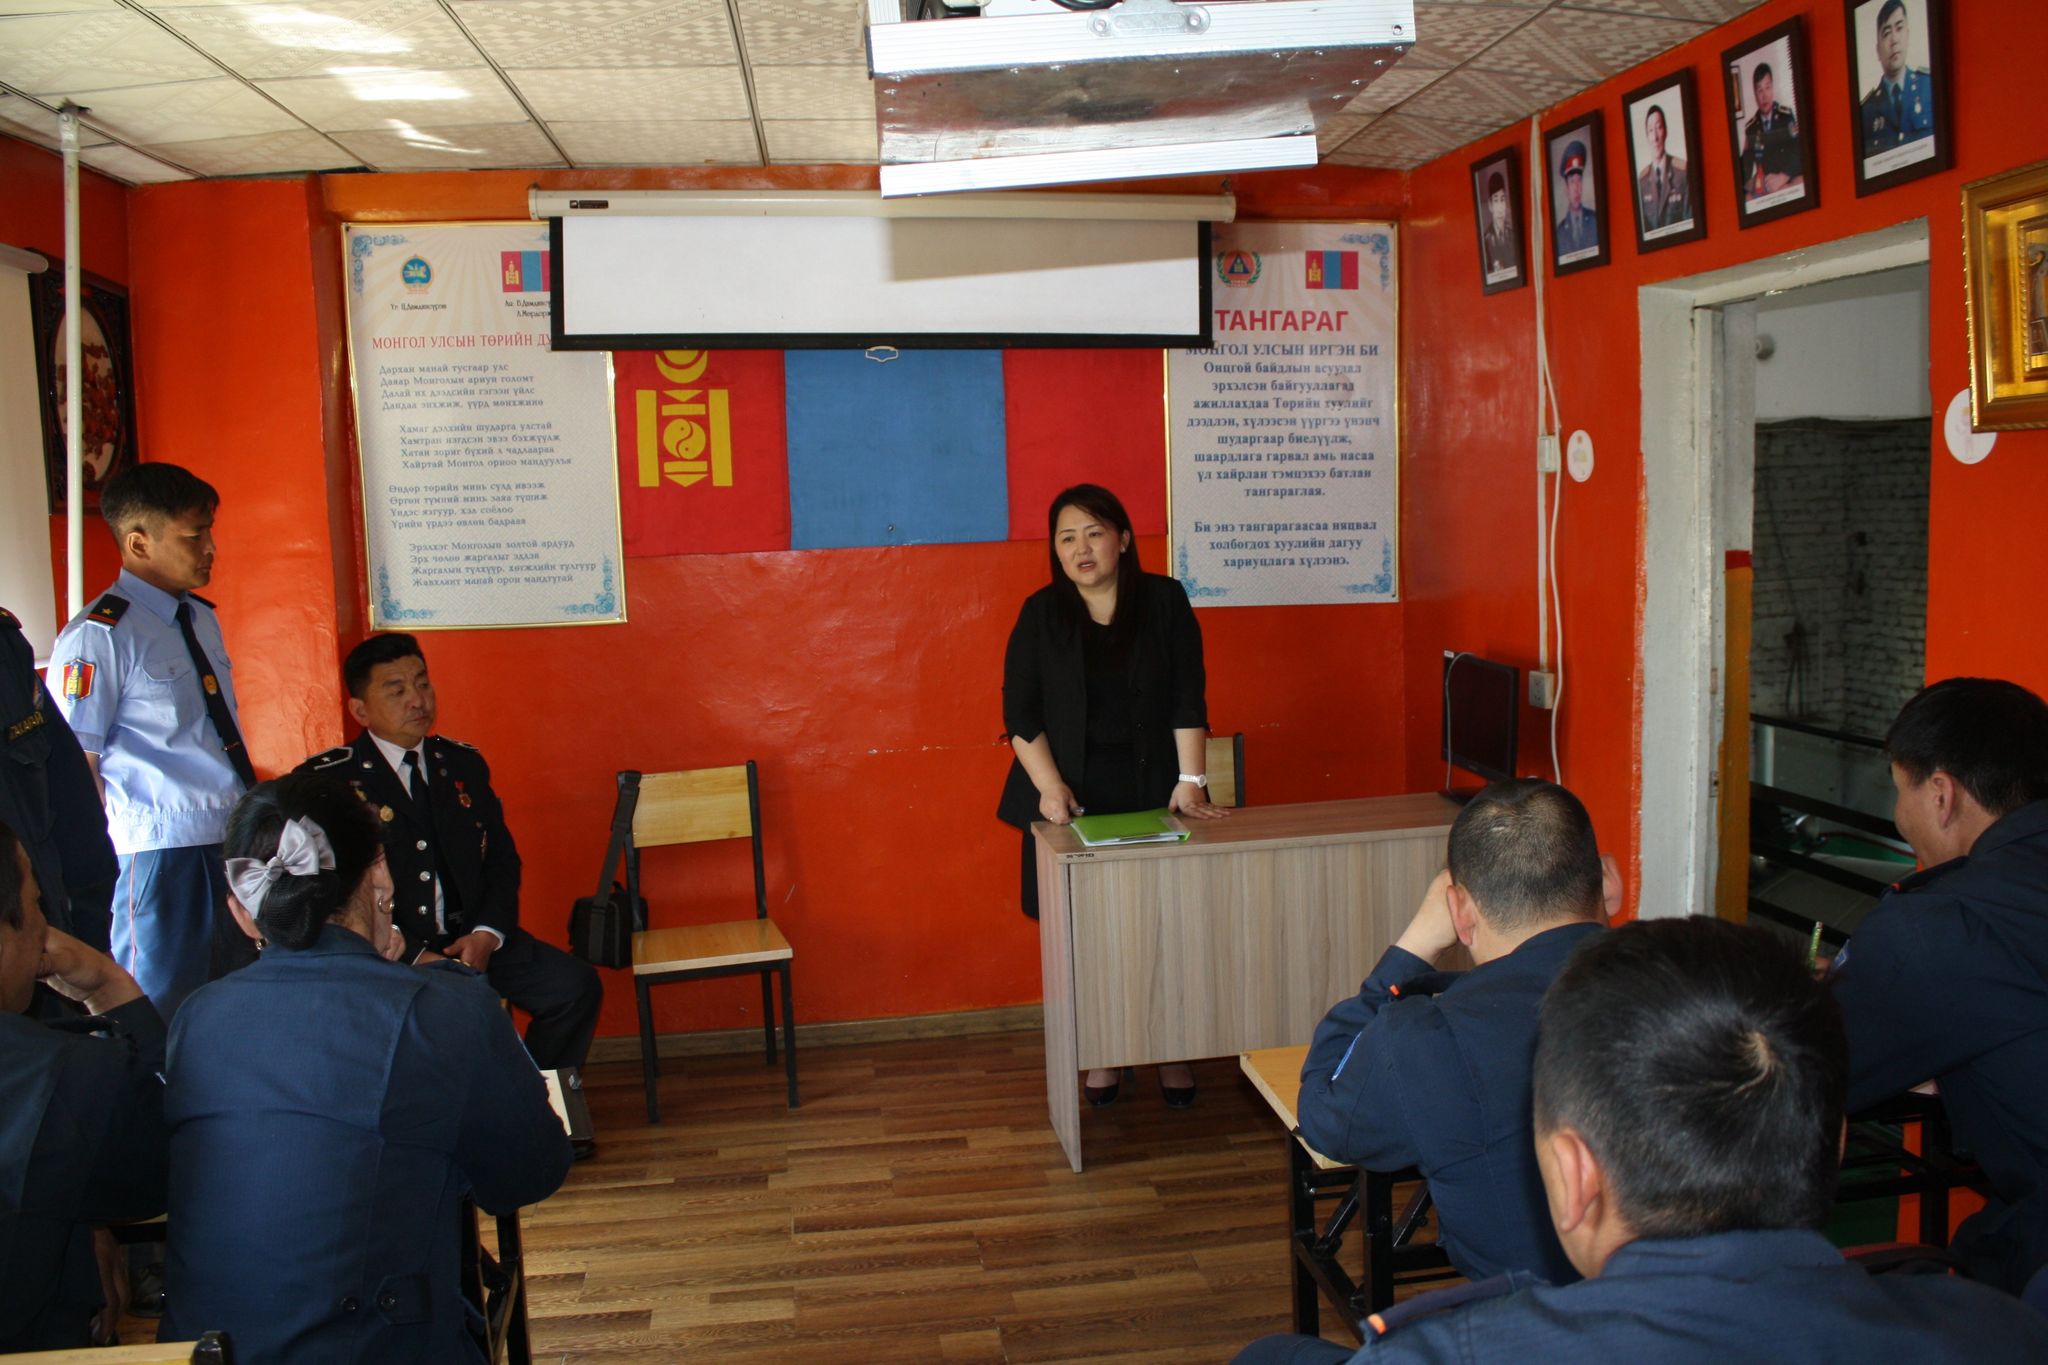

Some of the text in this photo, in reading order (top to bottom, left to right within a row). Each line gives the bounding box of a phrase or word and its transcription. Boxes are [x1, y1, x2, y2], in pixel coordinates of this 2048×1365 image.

[1214, 309, 1349, 332] ТАНГАРАГ
[372, 336, 425, 349] МОНГОЛ
[430, 335, 475, 348] УЛСЫН
[480, 332, 532, 347] ТӨРИЙН
[1252, 343, 1305, 356] УЛСЫН
[1309, 343, 1355, 356] ИРГЭН
[1359, 344, 1379, 356] БИ
[1203, 361, 1252, 376] Онцгой
[1255, 361, 1311, 376] байдлын
[1212, 381, 1267, 394] эрхэлсэн
[1193, 399, 1269, 410] ажиллахдаа
[1217, 434, 1284, 447] шударгаар
[1194, 452, 1375, 465] шаардлага гарвал амь насаа
[1216, 468, 1268, 482] хайрлан
[1329, 467, 1372, 478] батлан
[1245, 487, 1326, 499] тангараглая.
[1194, 521, 1211, 533] Би
[1214, 523, 1235, 532] энэ
[1209, 538, 1363, 551] холбогдох хуулийн дагуу
[1223, 557, 1295, 569] хариуцлага
